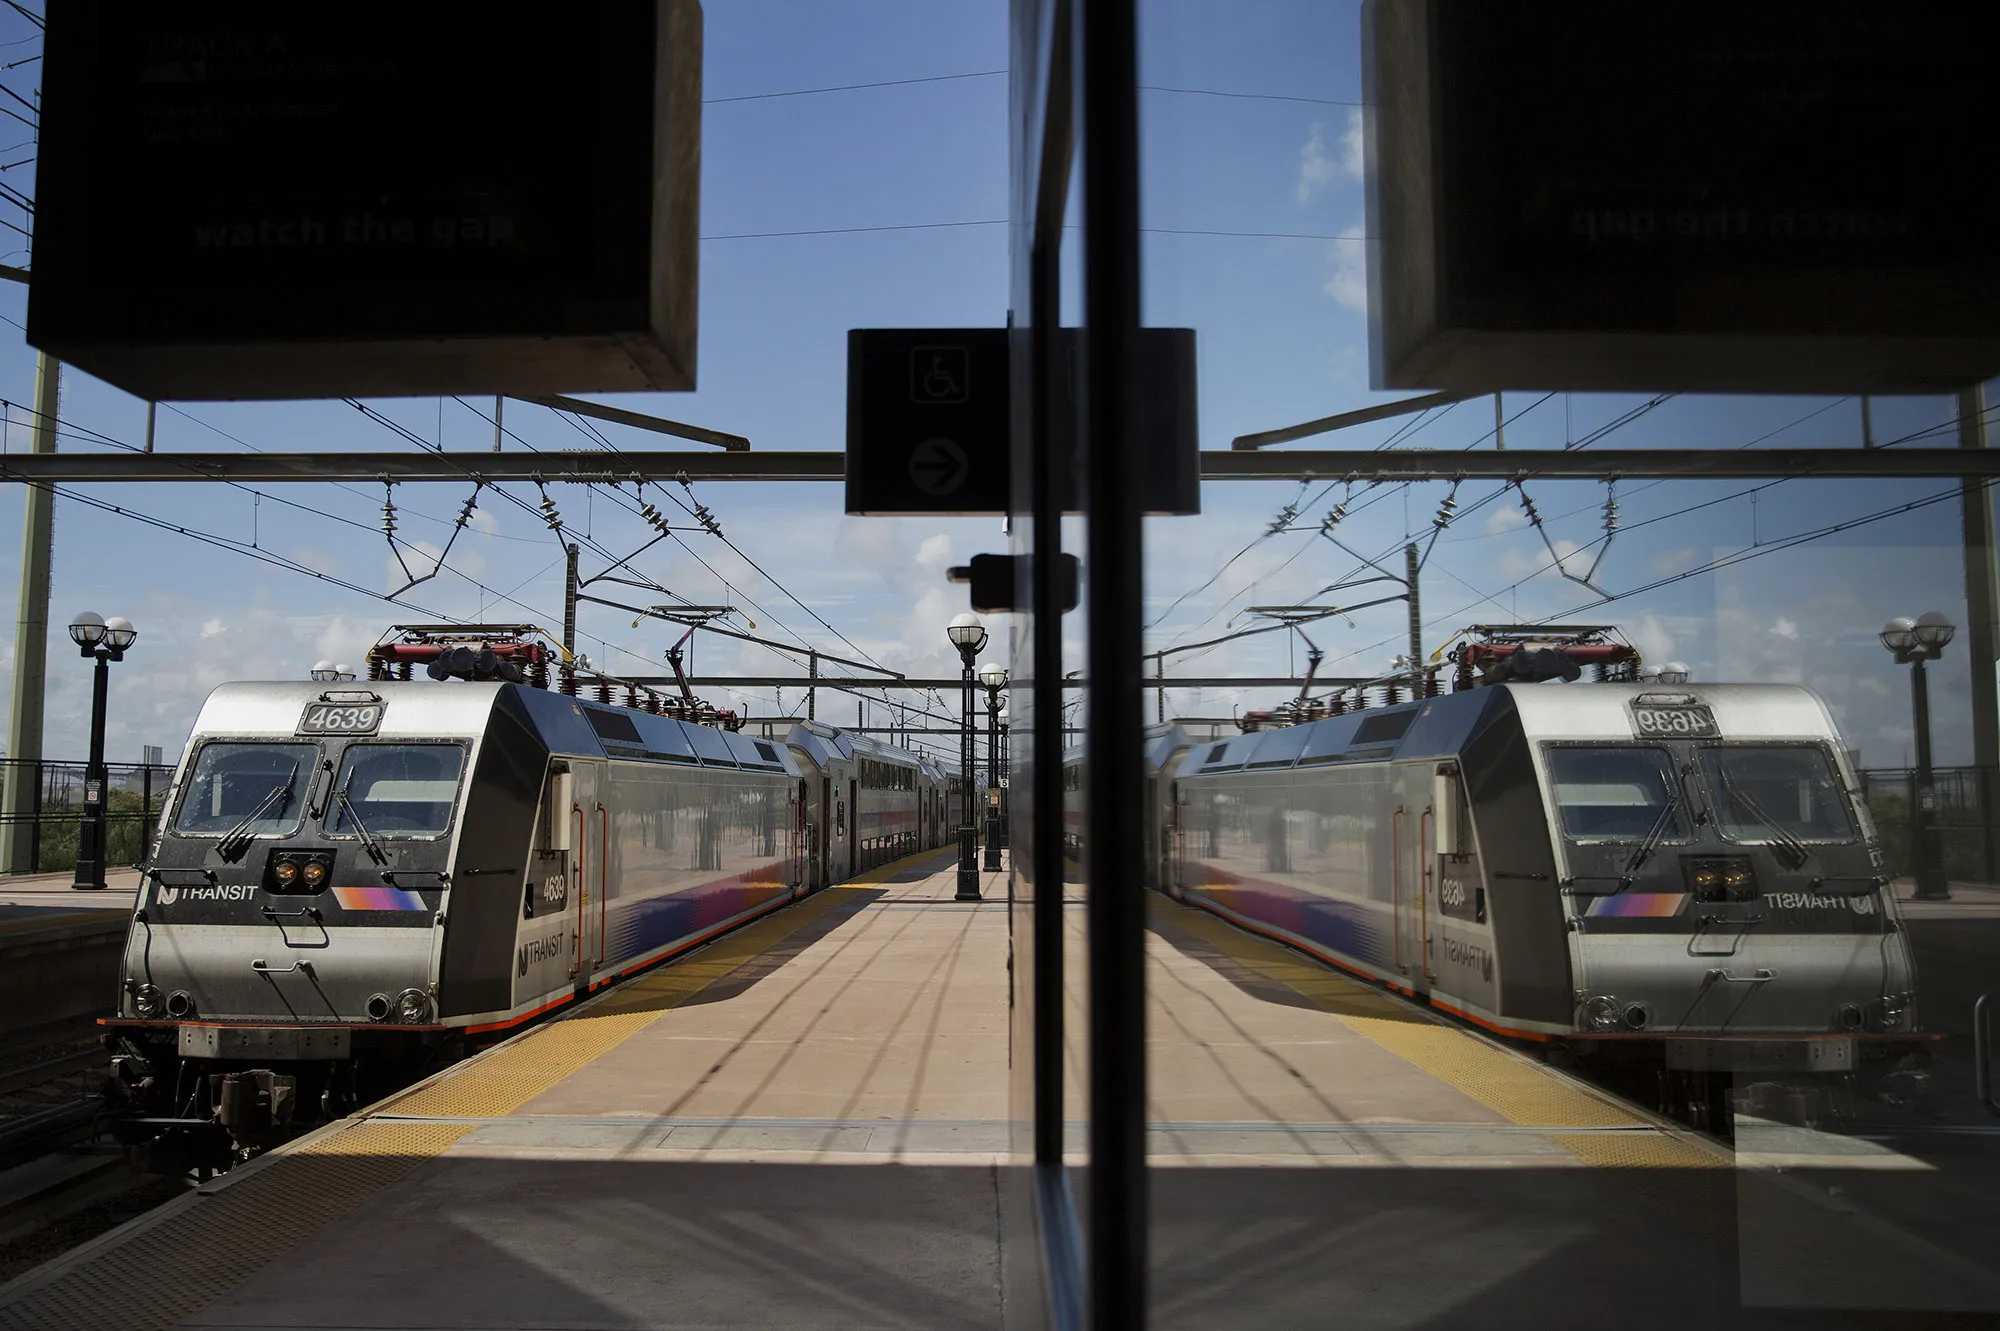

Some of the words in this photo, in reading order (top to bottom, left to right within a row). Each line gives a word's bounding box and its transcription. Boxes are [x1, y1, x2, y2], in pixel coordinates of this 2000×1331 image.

[195, 212, 325, 248] watch
[343, 212, 415, 244] the
[430, 215, 515, 249] gap
[308, 707, 375, 730] 4639
[182, 884, 259, 902] TRANSIT
[544, 874, 564, 902] 4639
[529, 933, 564, 964] TRANSIT
